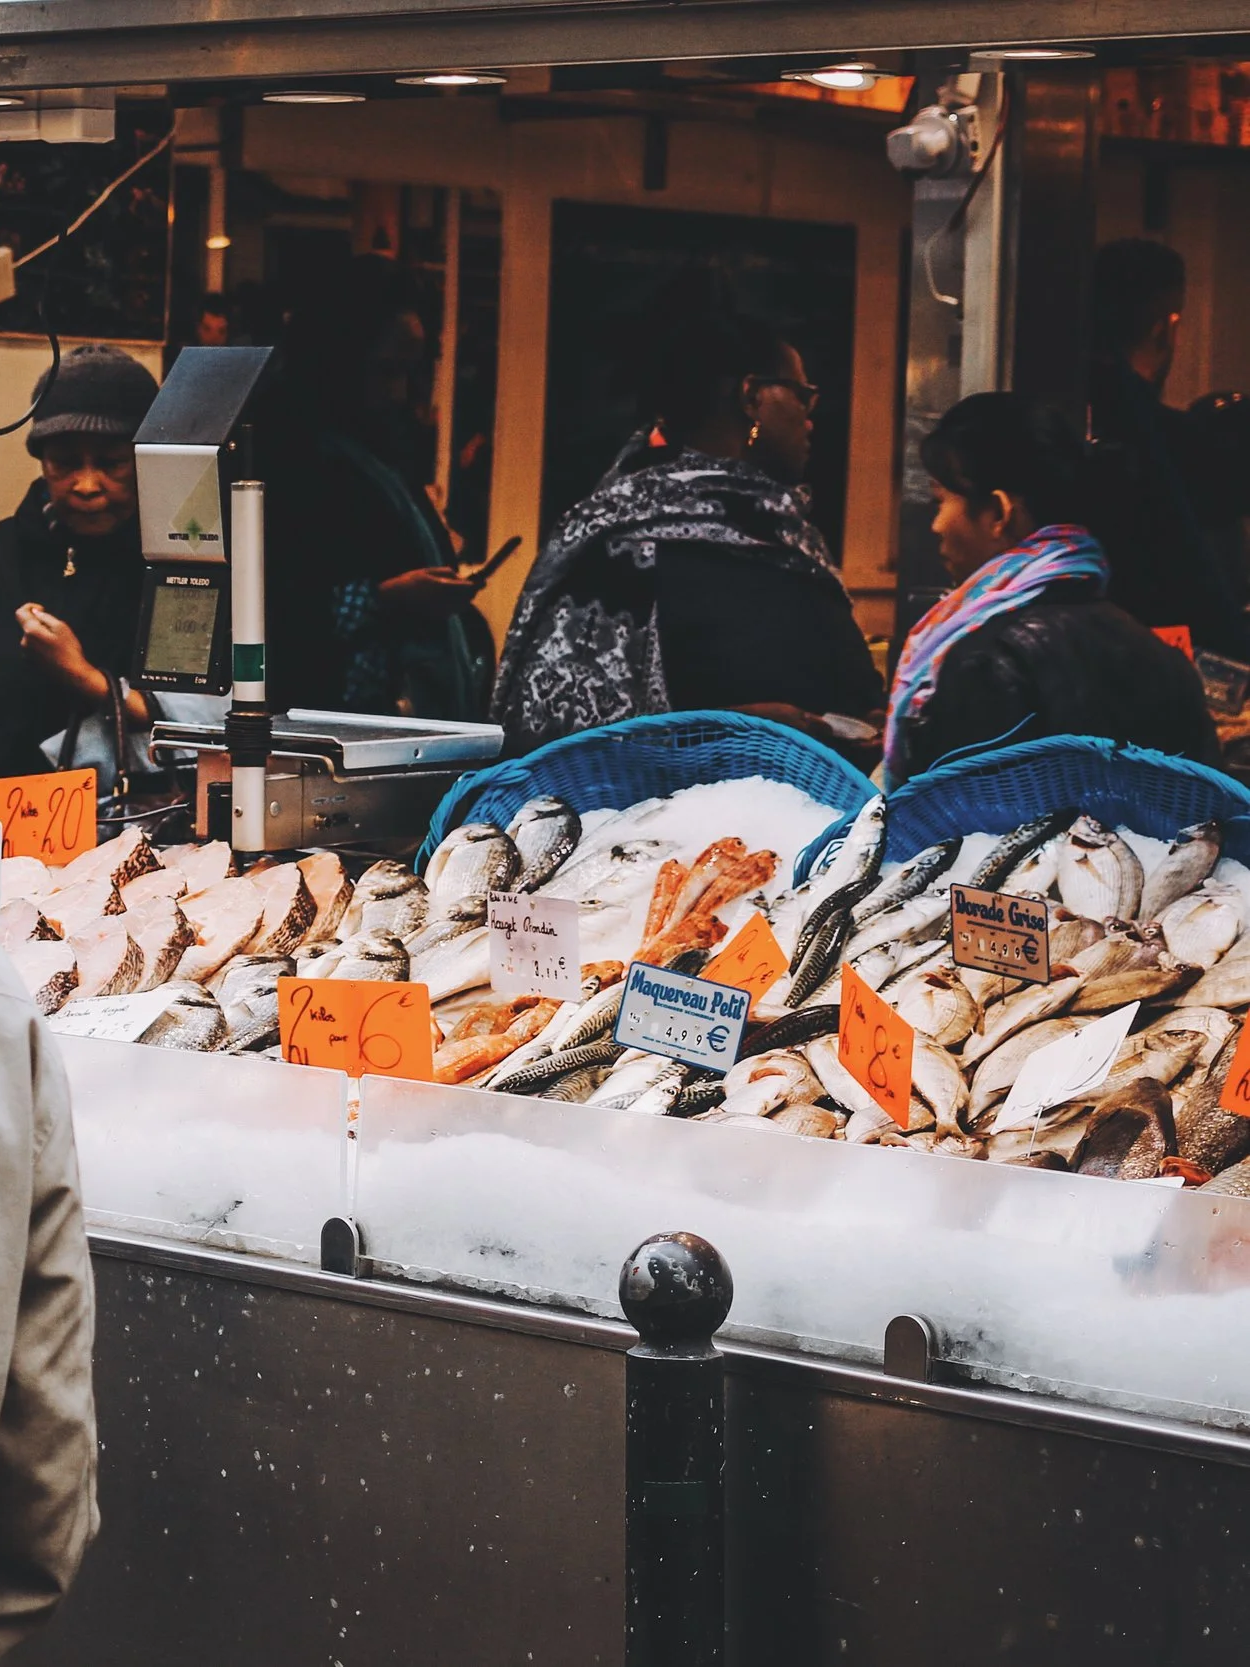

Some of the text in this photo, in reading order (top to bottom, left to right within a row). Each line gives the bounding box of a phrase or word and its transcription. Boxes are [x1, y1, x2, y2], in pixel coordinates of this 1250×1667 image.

[198, 533, 219, 541] TOLEDO
[166, 576, 210, 586] METTLER TOLEDO
[954, 890, 1005, 923] Dorade
[1009, 902, 1046, 932] Grise
[630, 969, 707, 1011] Maquereau
[710, 991, 746, 1020] Petit
[310, 1006, 336, 1023] kilos
[329, 1034, 348, 1045] pour
